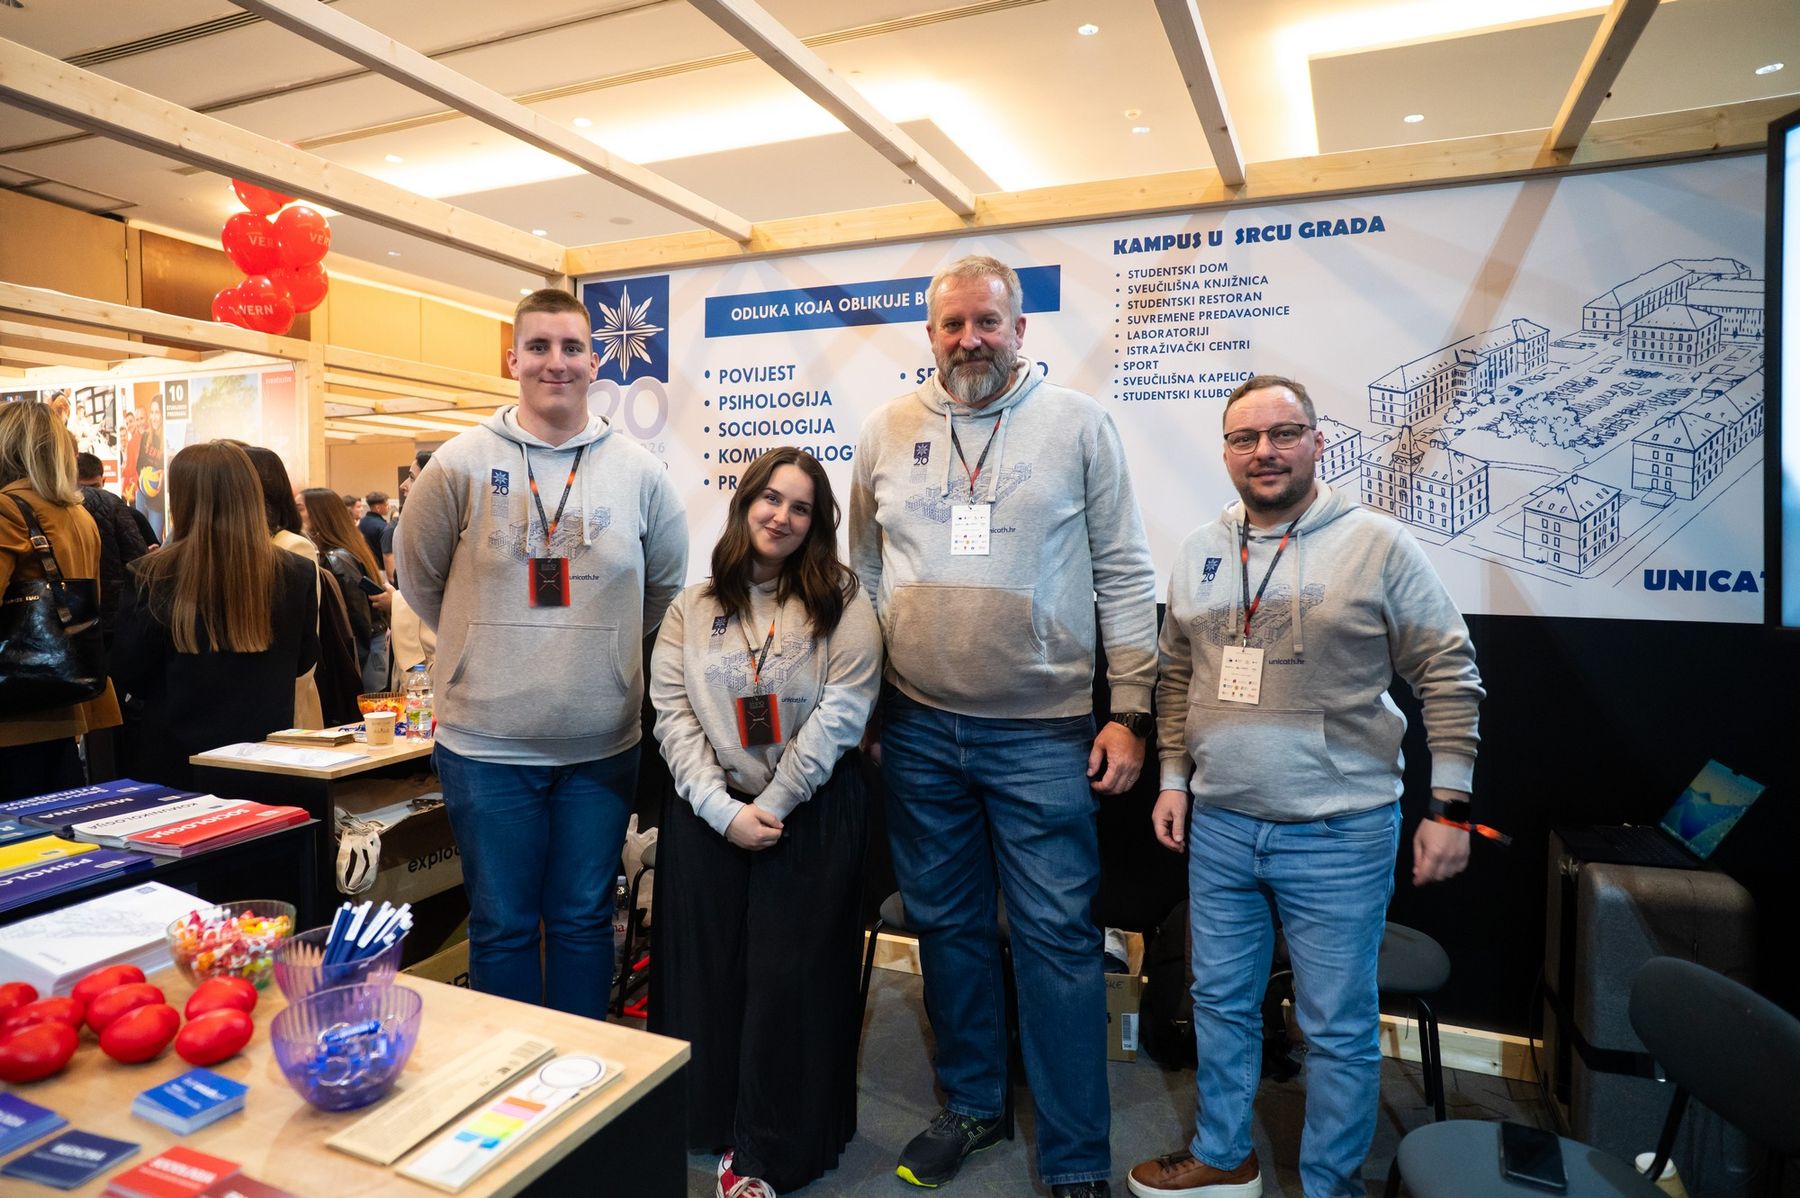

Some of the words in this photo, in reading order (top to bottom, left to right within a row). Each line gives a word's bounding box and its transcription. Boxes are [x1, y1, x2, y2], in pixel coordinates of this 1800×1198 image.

[247, 234, 274, 248] VER
[309, 231, 331, 246] VER
[1113, 231, 1202, 255] KAMPUS
[1208, 230, 1223, 247] U
[1234, 223, 1292, 246] SRCU
[1298, 215, 1386, 239] GRADA
[1127, 264, 1196, 280] STUDENTSKI
[1199, 262, 1229, 274] DOM
[1127, 278, 1200, 295] SVEUČILIŠNA
[1204, 274, 1269, 291] KNJIŽNICA
[730, 302, 790, 322] ODLUKA
[794, 298, 835, 318] KOJA
[839, 292, 910, 313] OBLIKUJE
[1127, 295, 1196, 310] STUDENTSKI
[1199, 291, 1263, 306] RESTORAN
[1127, 310, 1196, 326] SUVREMENE
[1198, 305, 1291, 321] PREDAVAONICE
[1127, 326, 1210, 341] LABORATORIJI
[1126, 340, 1206, 356] ISTRAŽIVAČKI
[1208, 339, 1251, 352] CENTRI
[718, 364, 796, 385] POVIJEST
[1123, 360, 1159, 371] SPORT
[1122, 372, 1195, 387] SVEUČILIŠNA
[1198, 371, 1256, 383] KAPELICA
[168, 384, 184, 402] 10
[718, 390, 833, 411] PSIHOLOGIJA
[1122, 387, 1191, 401] STUDENTSKI
[1193, 387, 1236, 400] KLUBO
[718, 418, 836, 438] SOCIOLOGIJA
[491, 485, 509, 496] 20
[1643, 569, 1766, 593] UNICA
[38, 797, 134, 819] MEDICINA
[88, 801, 199, 831] KOMUNIKOLOGIJA
[145, 808, 250, 839] SOCIOLOGIJA
[0, 858, 94, 887] PSIHOLO
